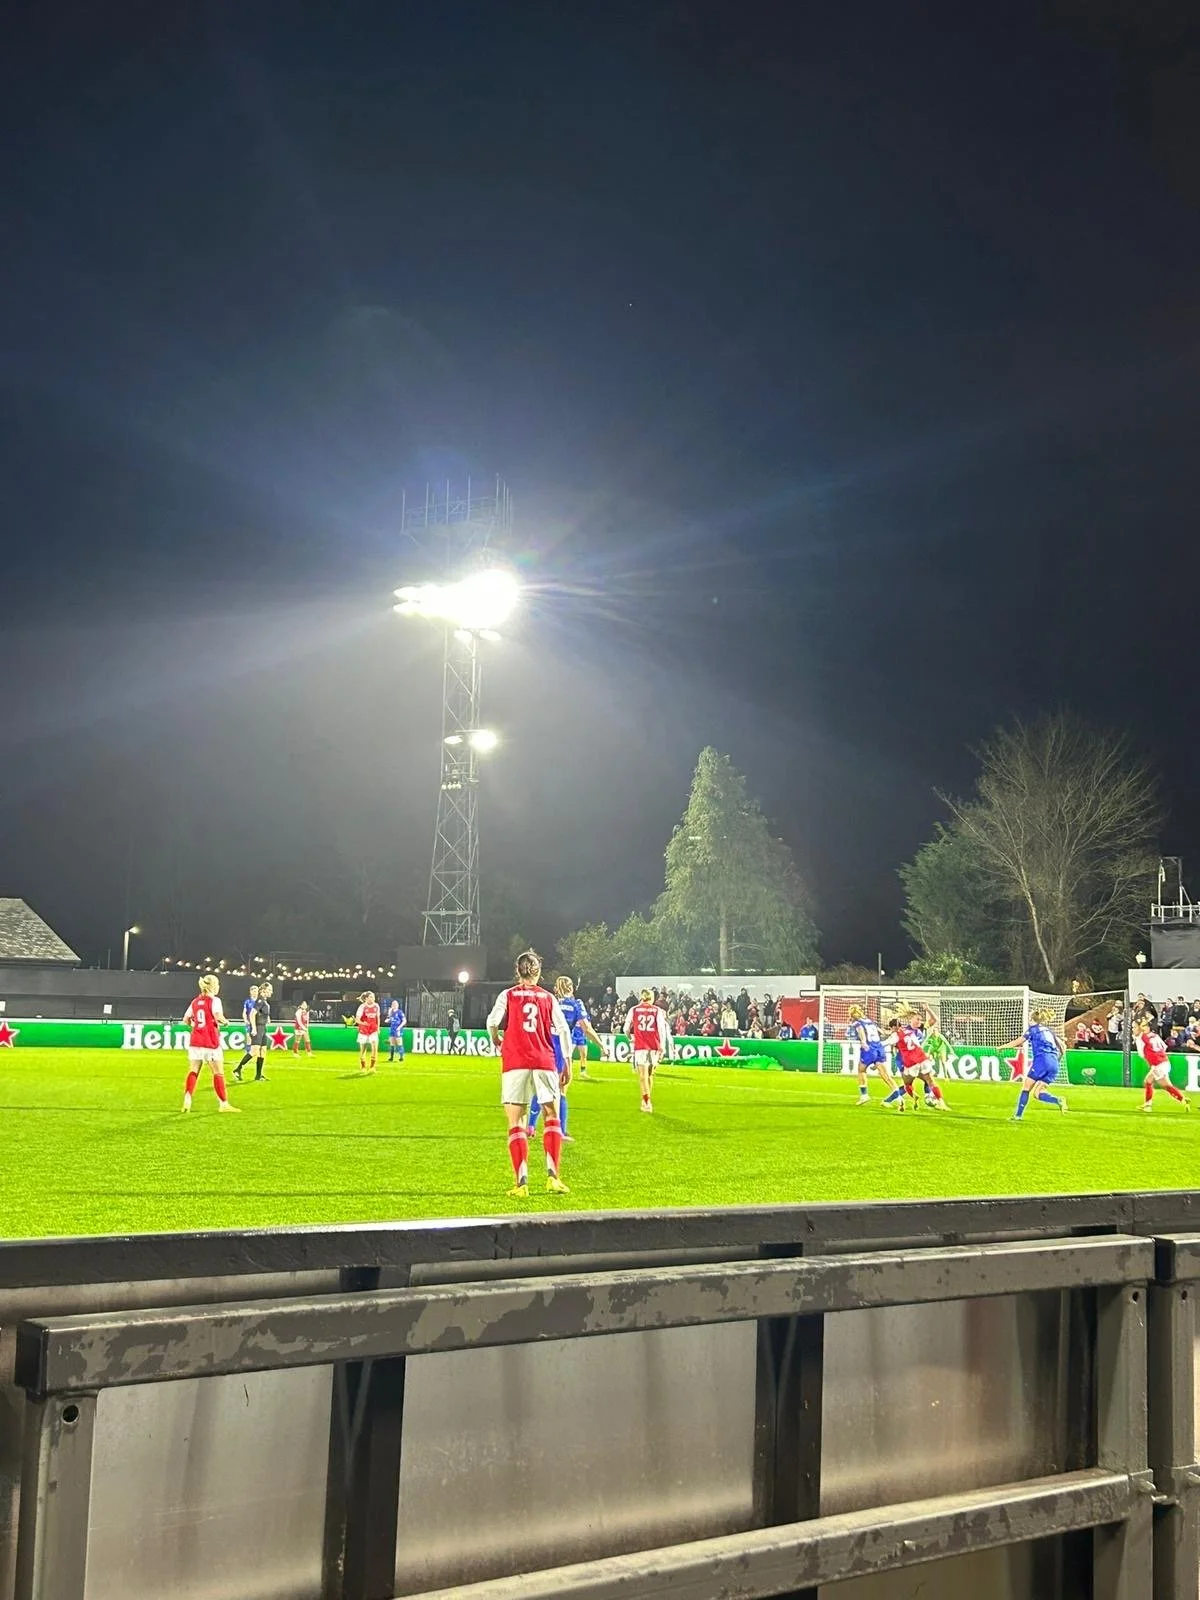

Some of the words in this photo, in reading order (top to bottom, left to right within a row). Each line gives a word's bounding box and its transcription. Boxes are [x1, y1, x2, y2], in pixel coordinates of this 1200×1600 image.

[196, 1008, 206, 1029] 9
[522, 1002, 538, 1033] 3
[637, 1014, 655, 1032] 32
[122, 1024, 247, 1050] Heinke
[601, 1034, 712, 1062] Heken
